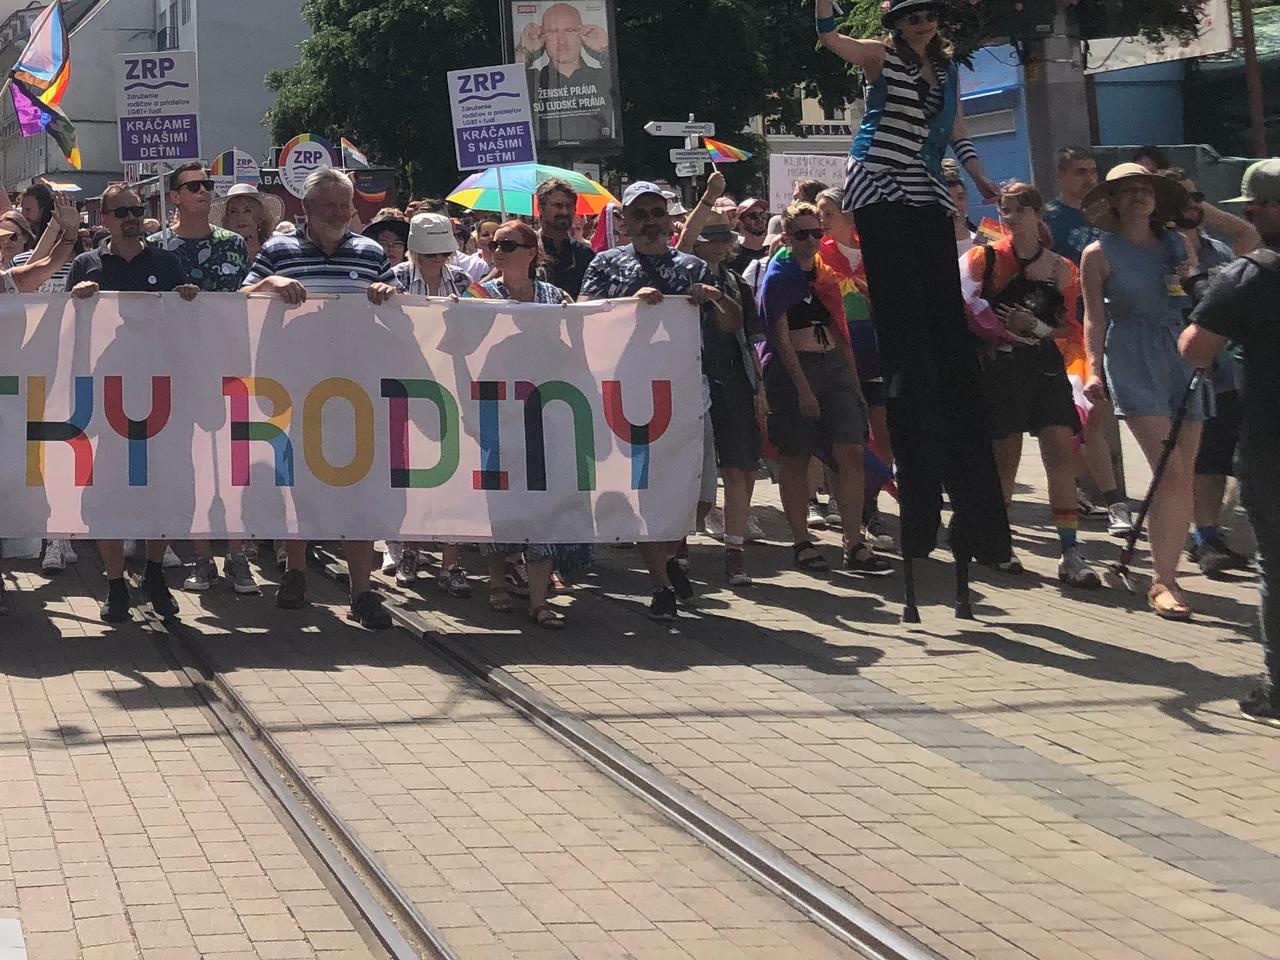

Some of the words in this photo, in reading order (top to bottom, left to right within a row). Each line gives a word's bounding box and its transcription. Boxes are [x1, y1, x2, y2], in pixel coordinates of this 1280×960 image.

[125, 58, 175, 80] ZRP
[457, 71, 505, 94] ZRP
[538, 85, 569, 99] ŽENSKÉ
[570, 83, 597, 96] PRÁVA
[533, 100, 544, 112] SÚ
[579, 95, 606, 108] PRÁVA
[126, 118, 191, 131] KRÁČAME
[131, 134, 139, 144] S
[143, 131, 188, 144] NAŠIMI
[463, 126, 524, 140] KRÁČAME
[140, 145, 180, 158] DEŤMI
[468, 143, 475, 152] S
[480, 138, 522, 151] NAŠIMI
[237, 158, 252, 166] ZRP
[294, 150, 322, 164] ZRP
[477, 151, 516, 163] DEŤMI
[222, 376, 673, 491] RODINY
